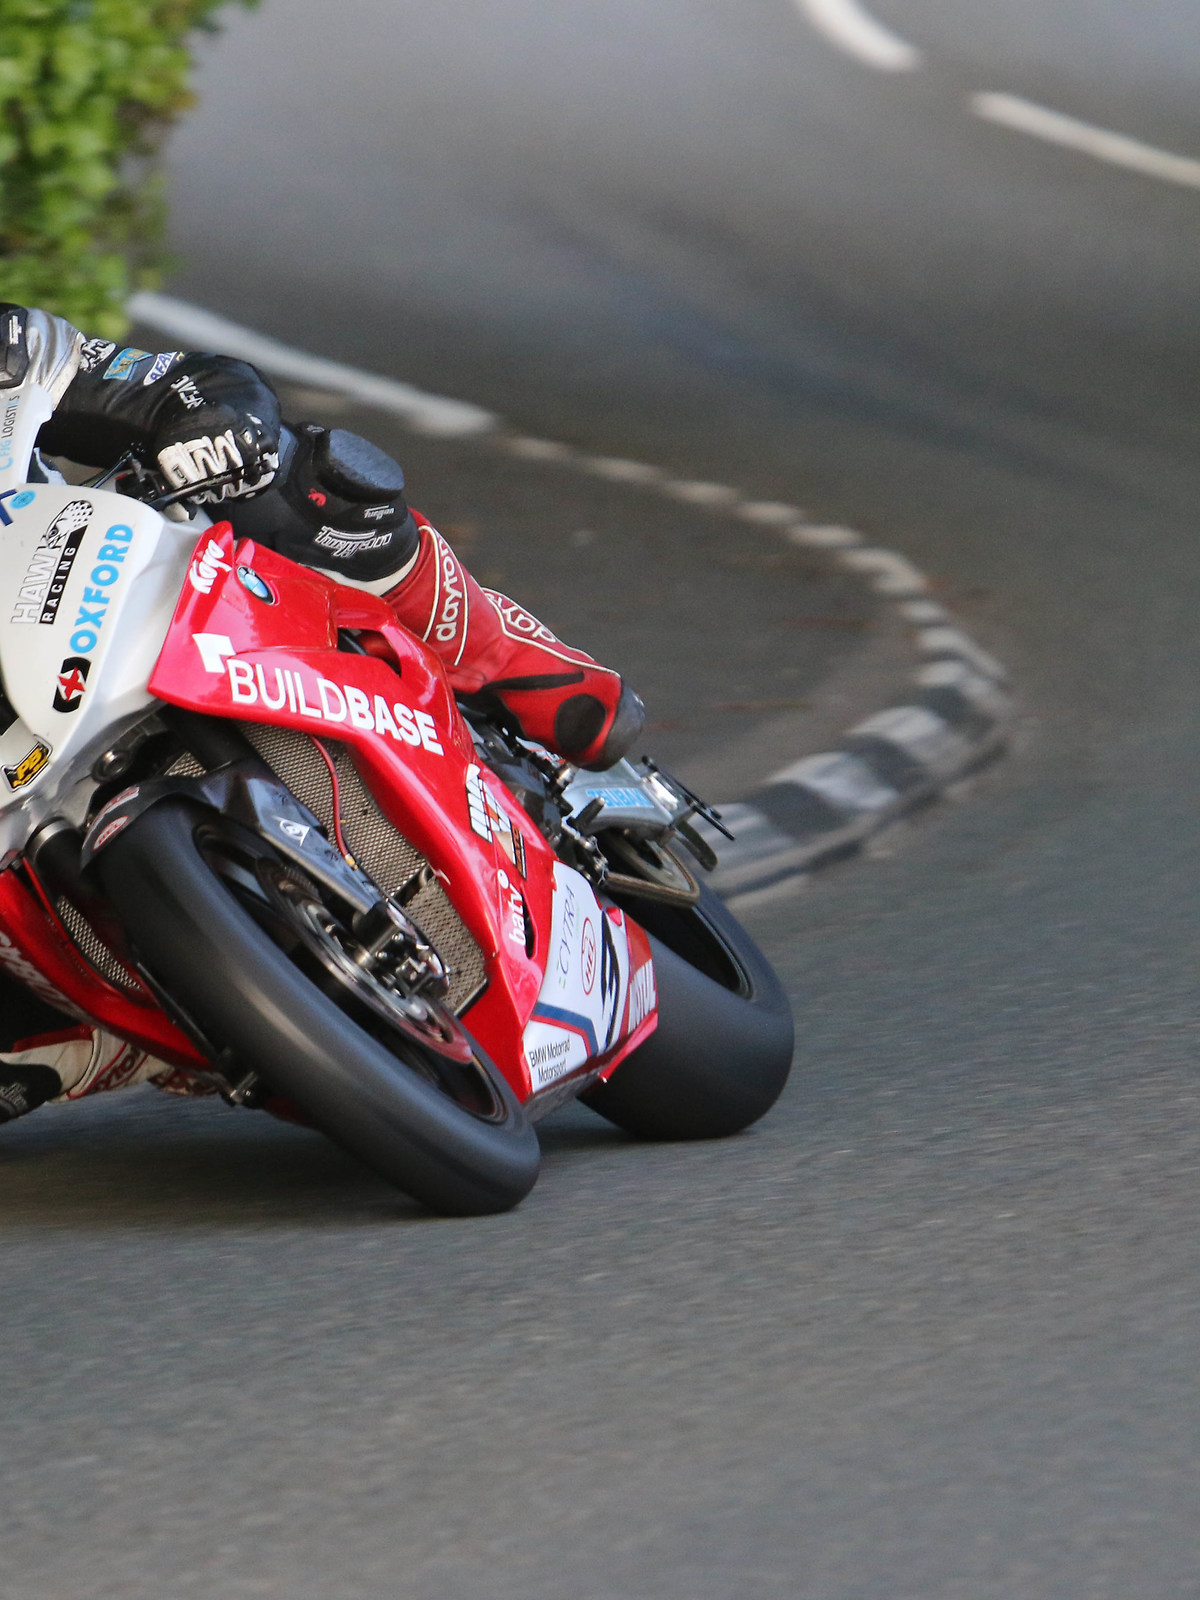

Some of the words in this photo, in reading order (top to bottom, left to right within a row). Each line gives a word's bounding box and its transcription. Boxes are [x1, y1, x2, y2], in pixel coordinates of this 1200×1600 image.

[1, 395, 20, 438] LOGISTICS
[11, 534, 63, 624] HAWK
[41, 547, 77, 622] RACING
[70, 523, 134, 654] OXFORD
[227, 659, 444, 756] BUILDBASE
[529, 1041, 548, 1068] BMW
[547, 1038, 571, 1062] Motorrad
[538, 1060, 568, 1084] Motorsport
